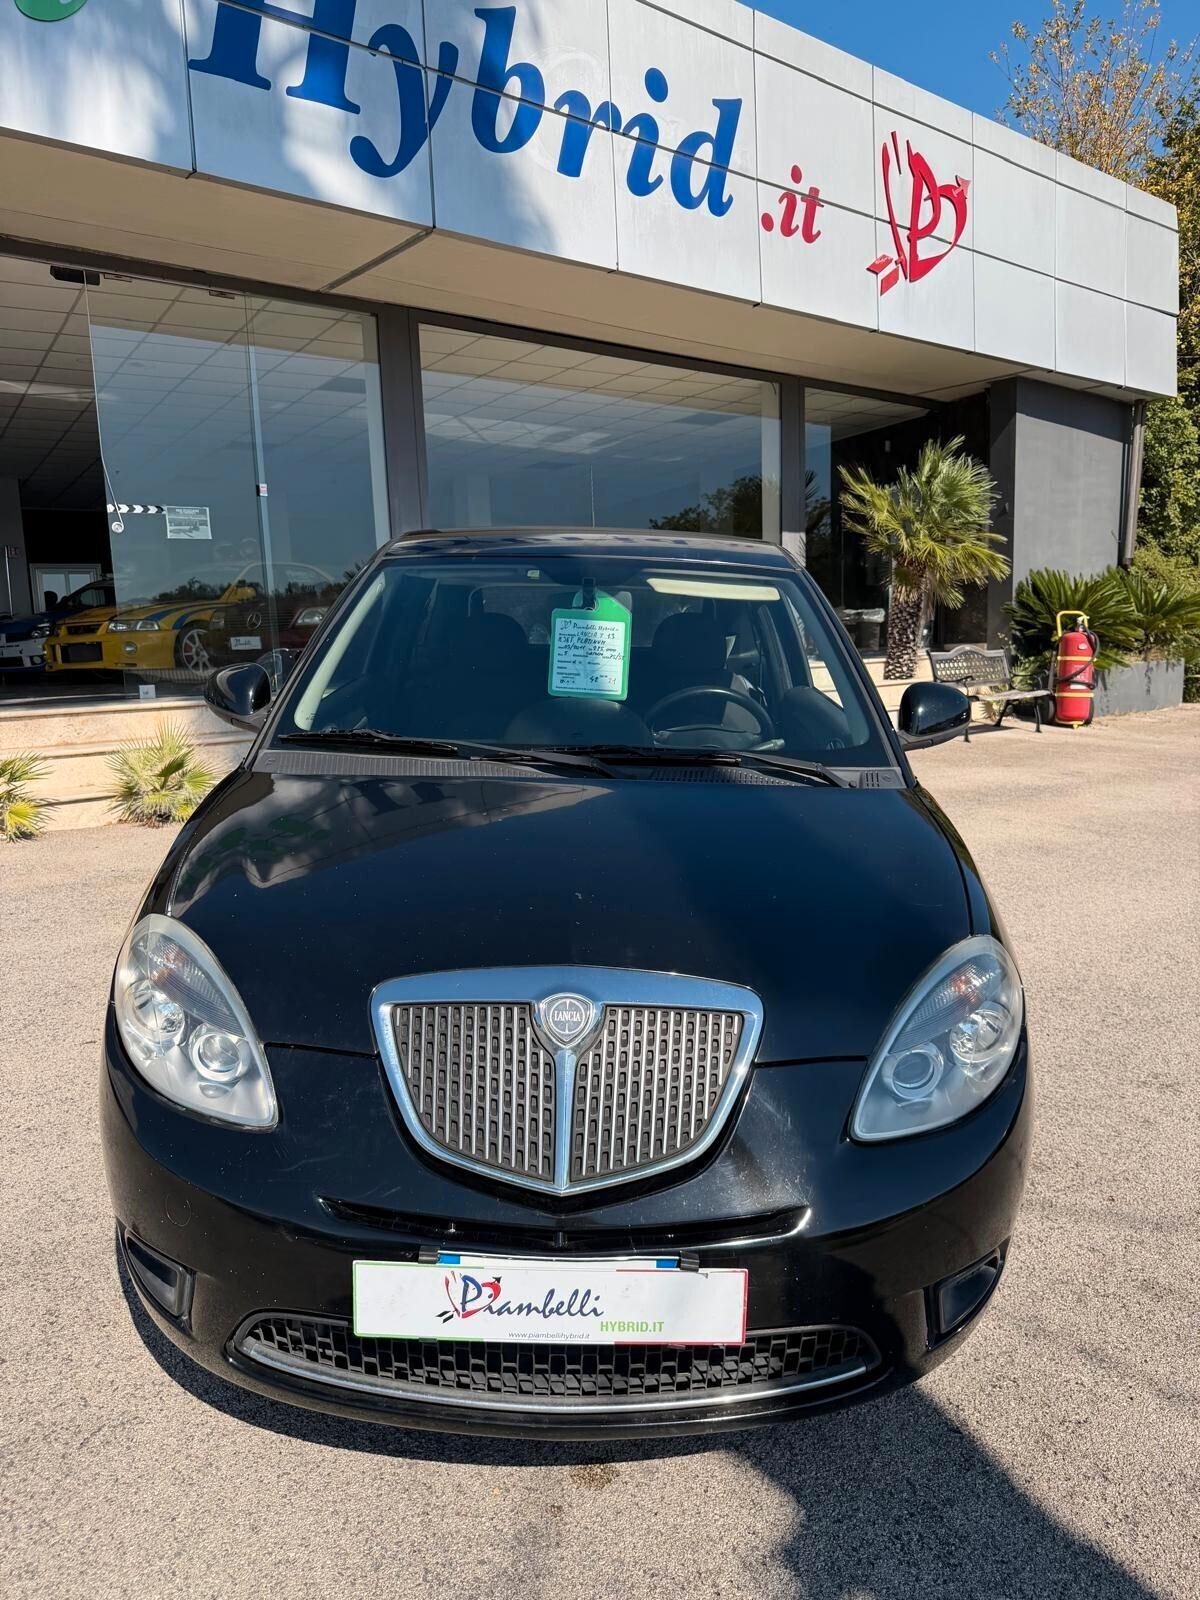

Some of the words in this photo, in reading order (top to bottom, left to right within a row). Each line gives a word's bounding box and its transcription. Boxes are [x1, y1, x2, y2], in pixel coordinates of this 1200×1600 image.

[554, 1010, 581, 1021] LANCIA
[460, 1274, 604, 1319] Piambelli
[600, 1321, 664, 1332] HYBRID.IT
